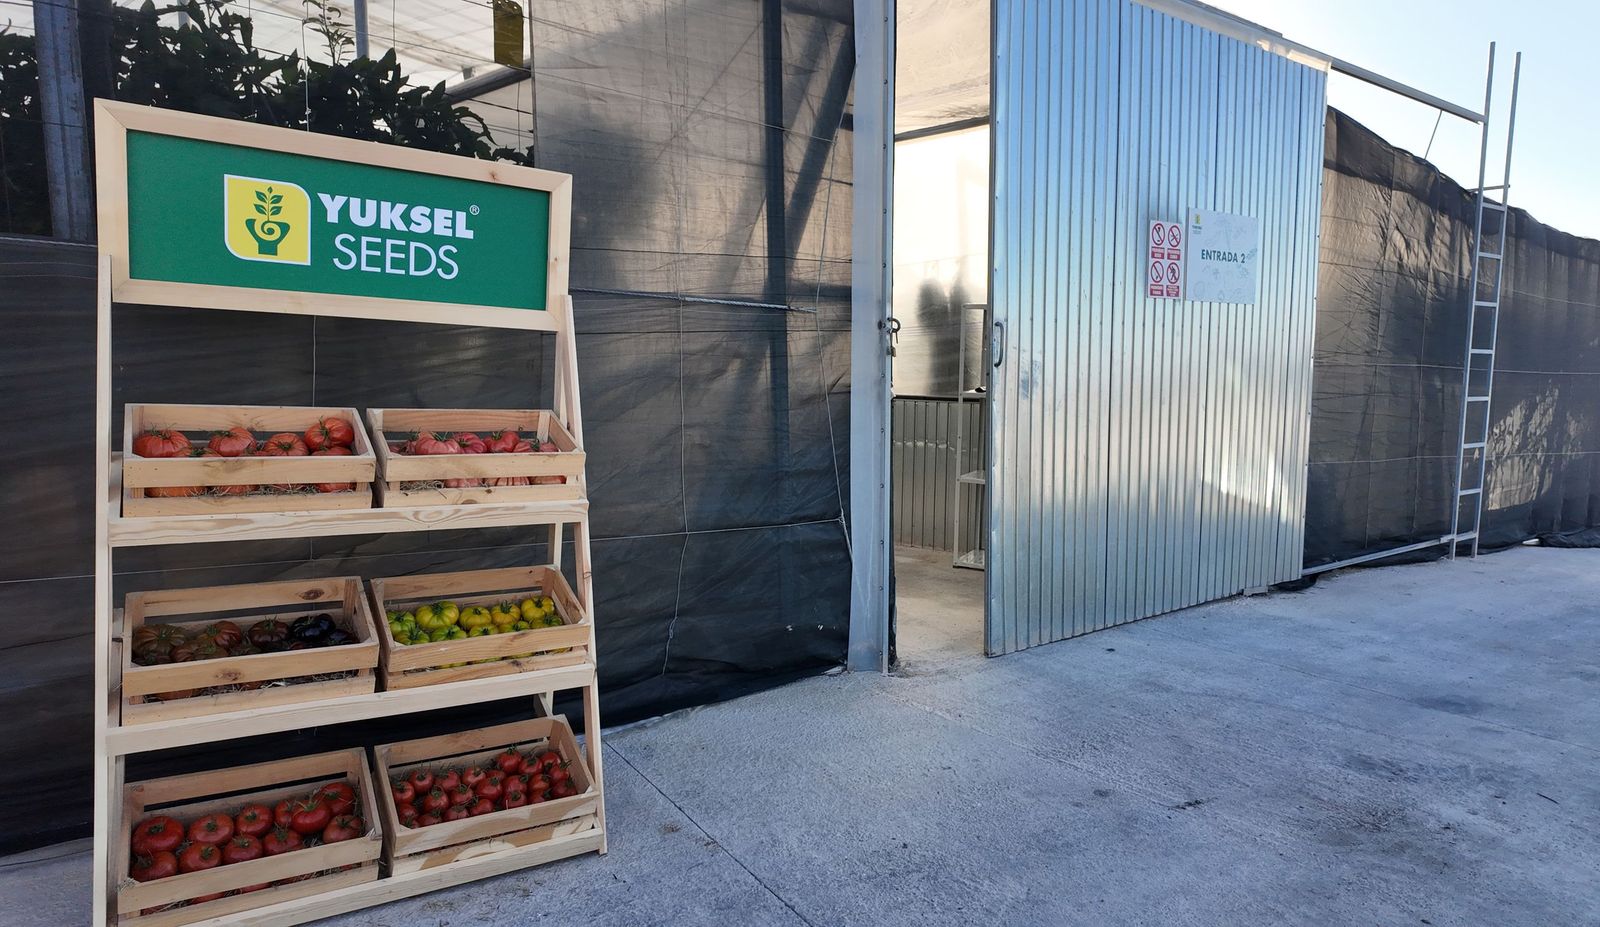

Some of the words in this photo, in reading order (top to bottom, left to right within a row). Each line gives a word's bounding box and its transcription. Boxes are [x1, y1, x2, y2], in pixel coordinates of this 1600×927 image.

[333, 233, 459, 280] SEEDS
[1201, 249, 1238, 263] ENTRADA
[1240, 253, 1246, 264] 2
